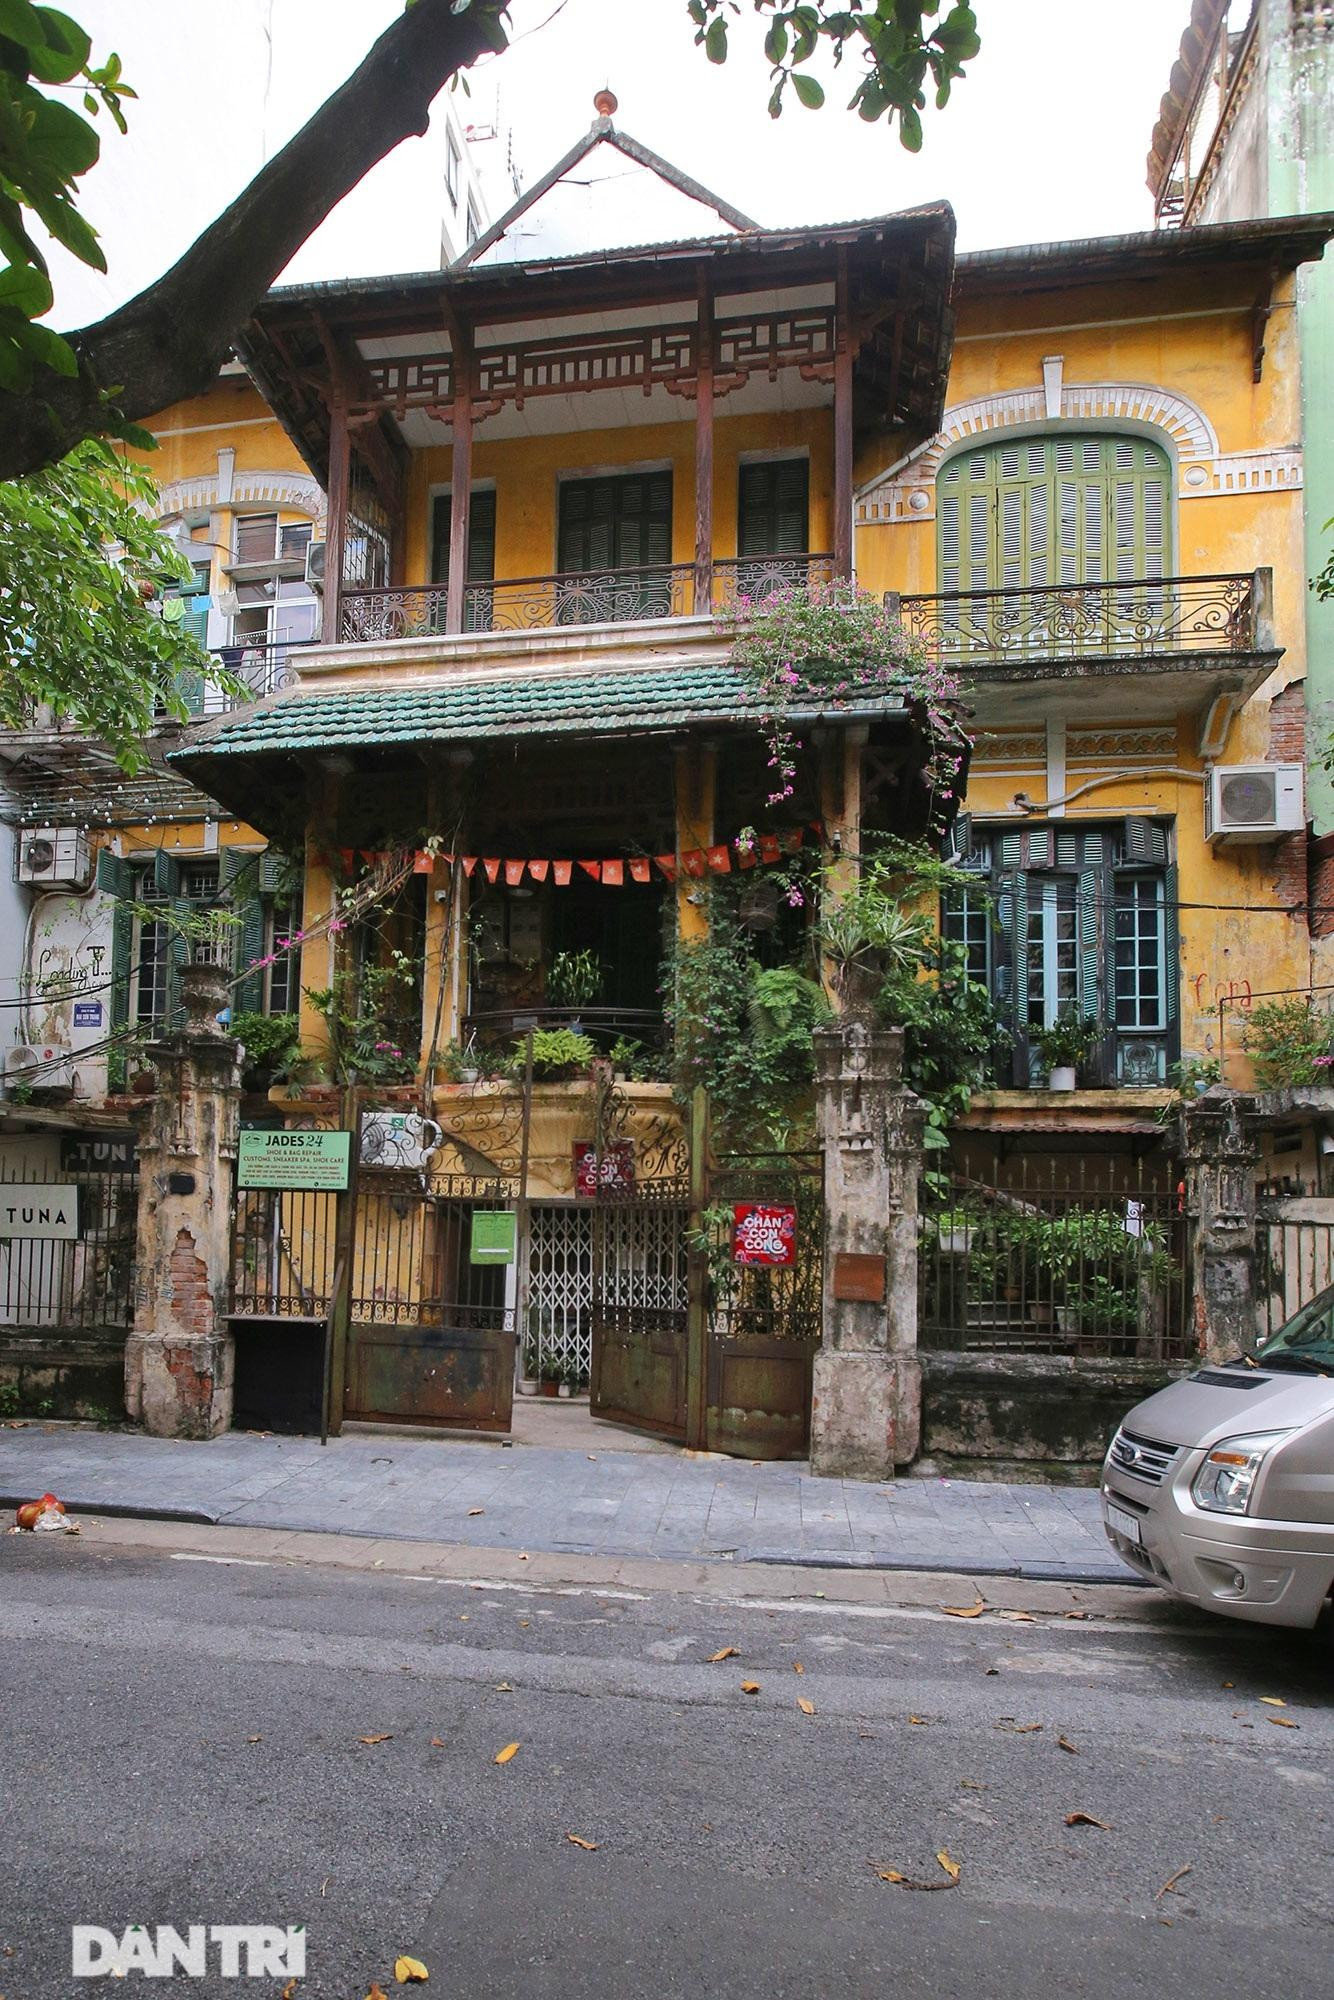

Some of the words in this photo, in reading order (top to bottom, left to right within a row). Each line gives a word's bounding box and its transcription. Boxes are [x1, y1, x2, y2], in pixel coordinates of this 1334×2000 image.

[265, 1135, 304, 1147] JADES
[305, 1134, 324, 1147] 24
[6, 1207, 67, 1225] TUNA
[749, 1228, 778, 1239] CON
[744, 1237, 787, 1254] CÔNG
